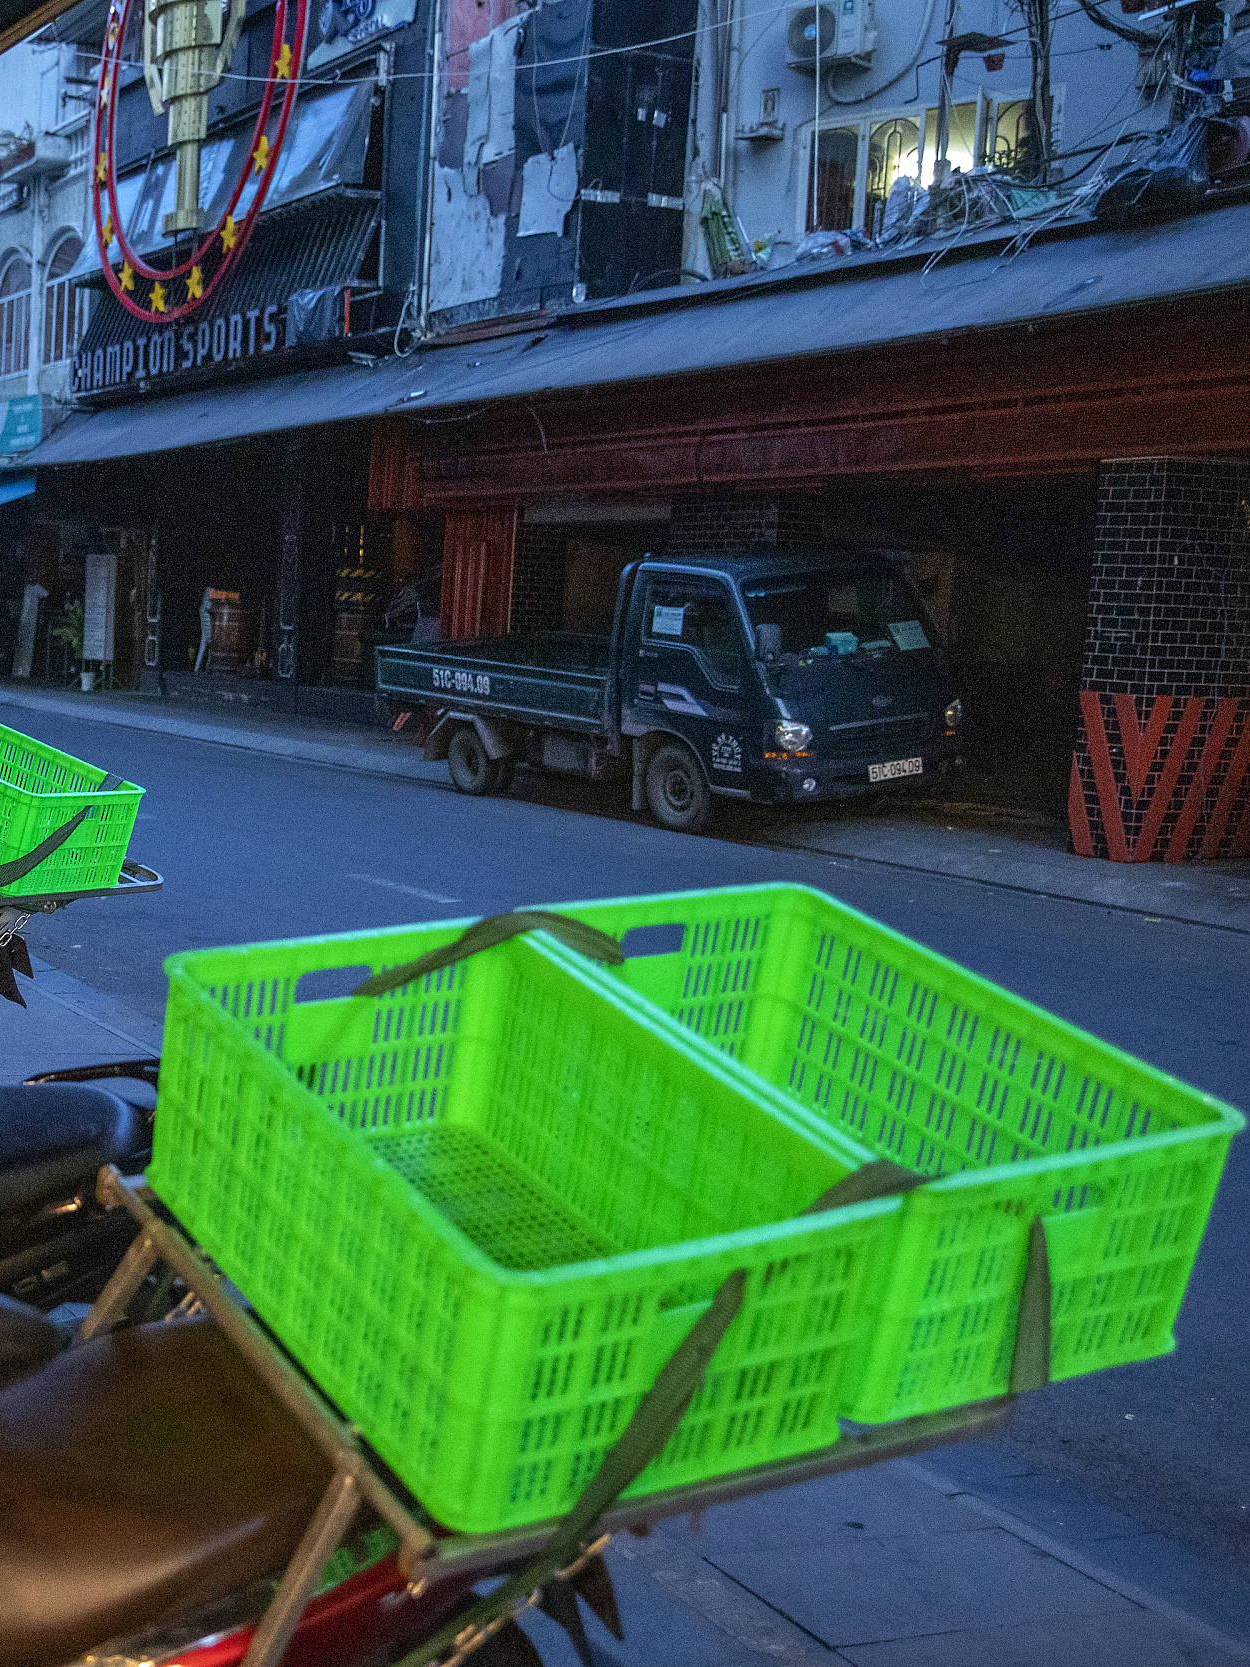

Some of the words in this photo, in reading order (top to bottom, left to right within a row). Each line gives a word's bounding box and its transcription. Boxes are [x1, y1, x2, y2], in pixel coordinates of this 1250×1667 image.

[71, 332, 175, 393] CHAMPION
[180, 305, 278, 369] SPORTS
[433, 669, 490, 695] 51C-094.09
